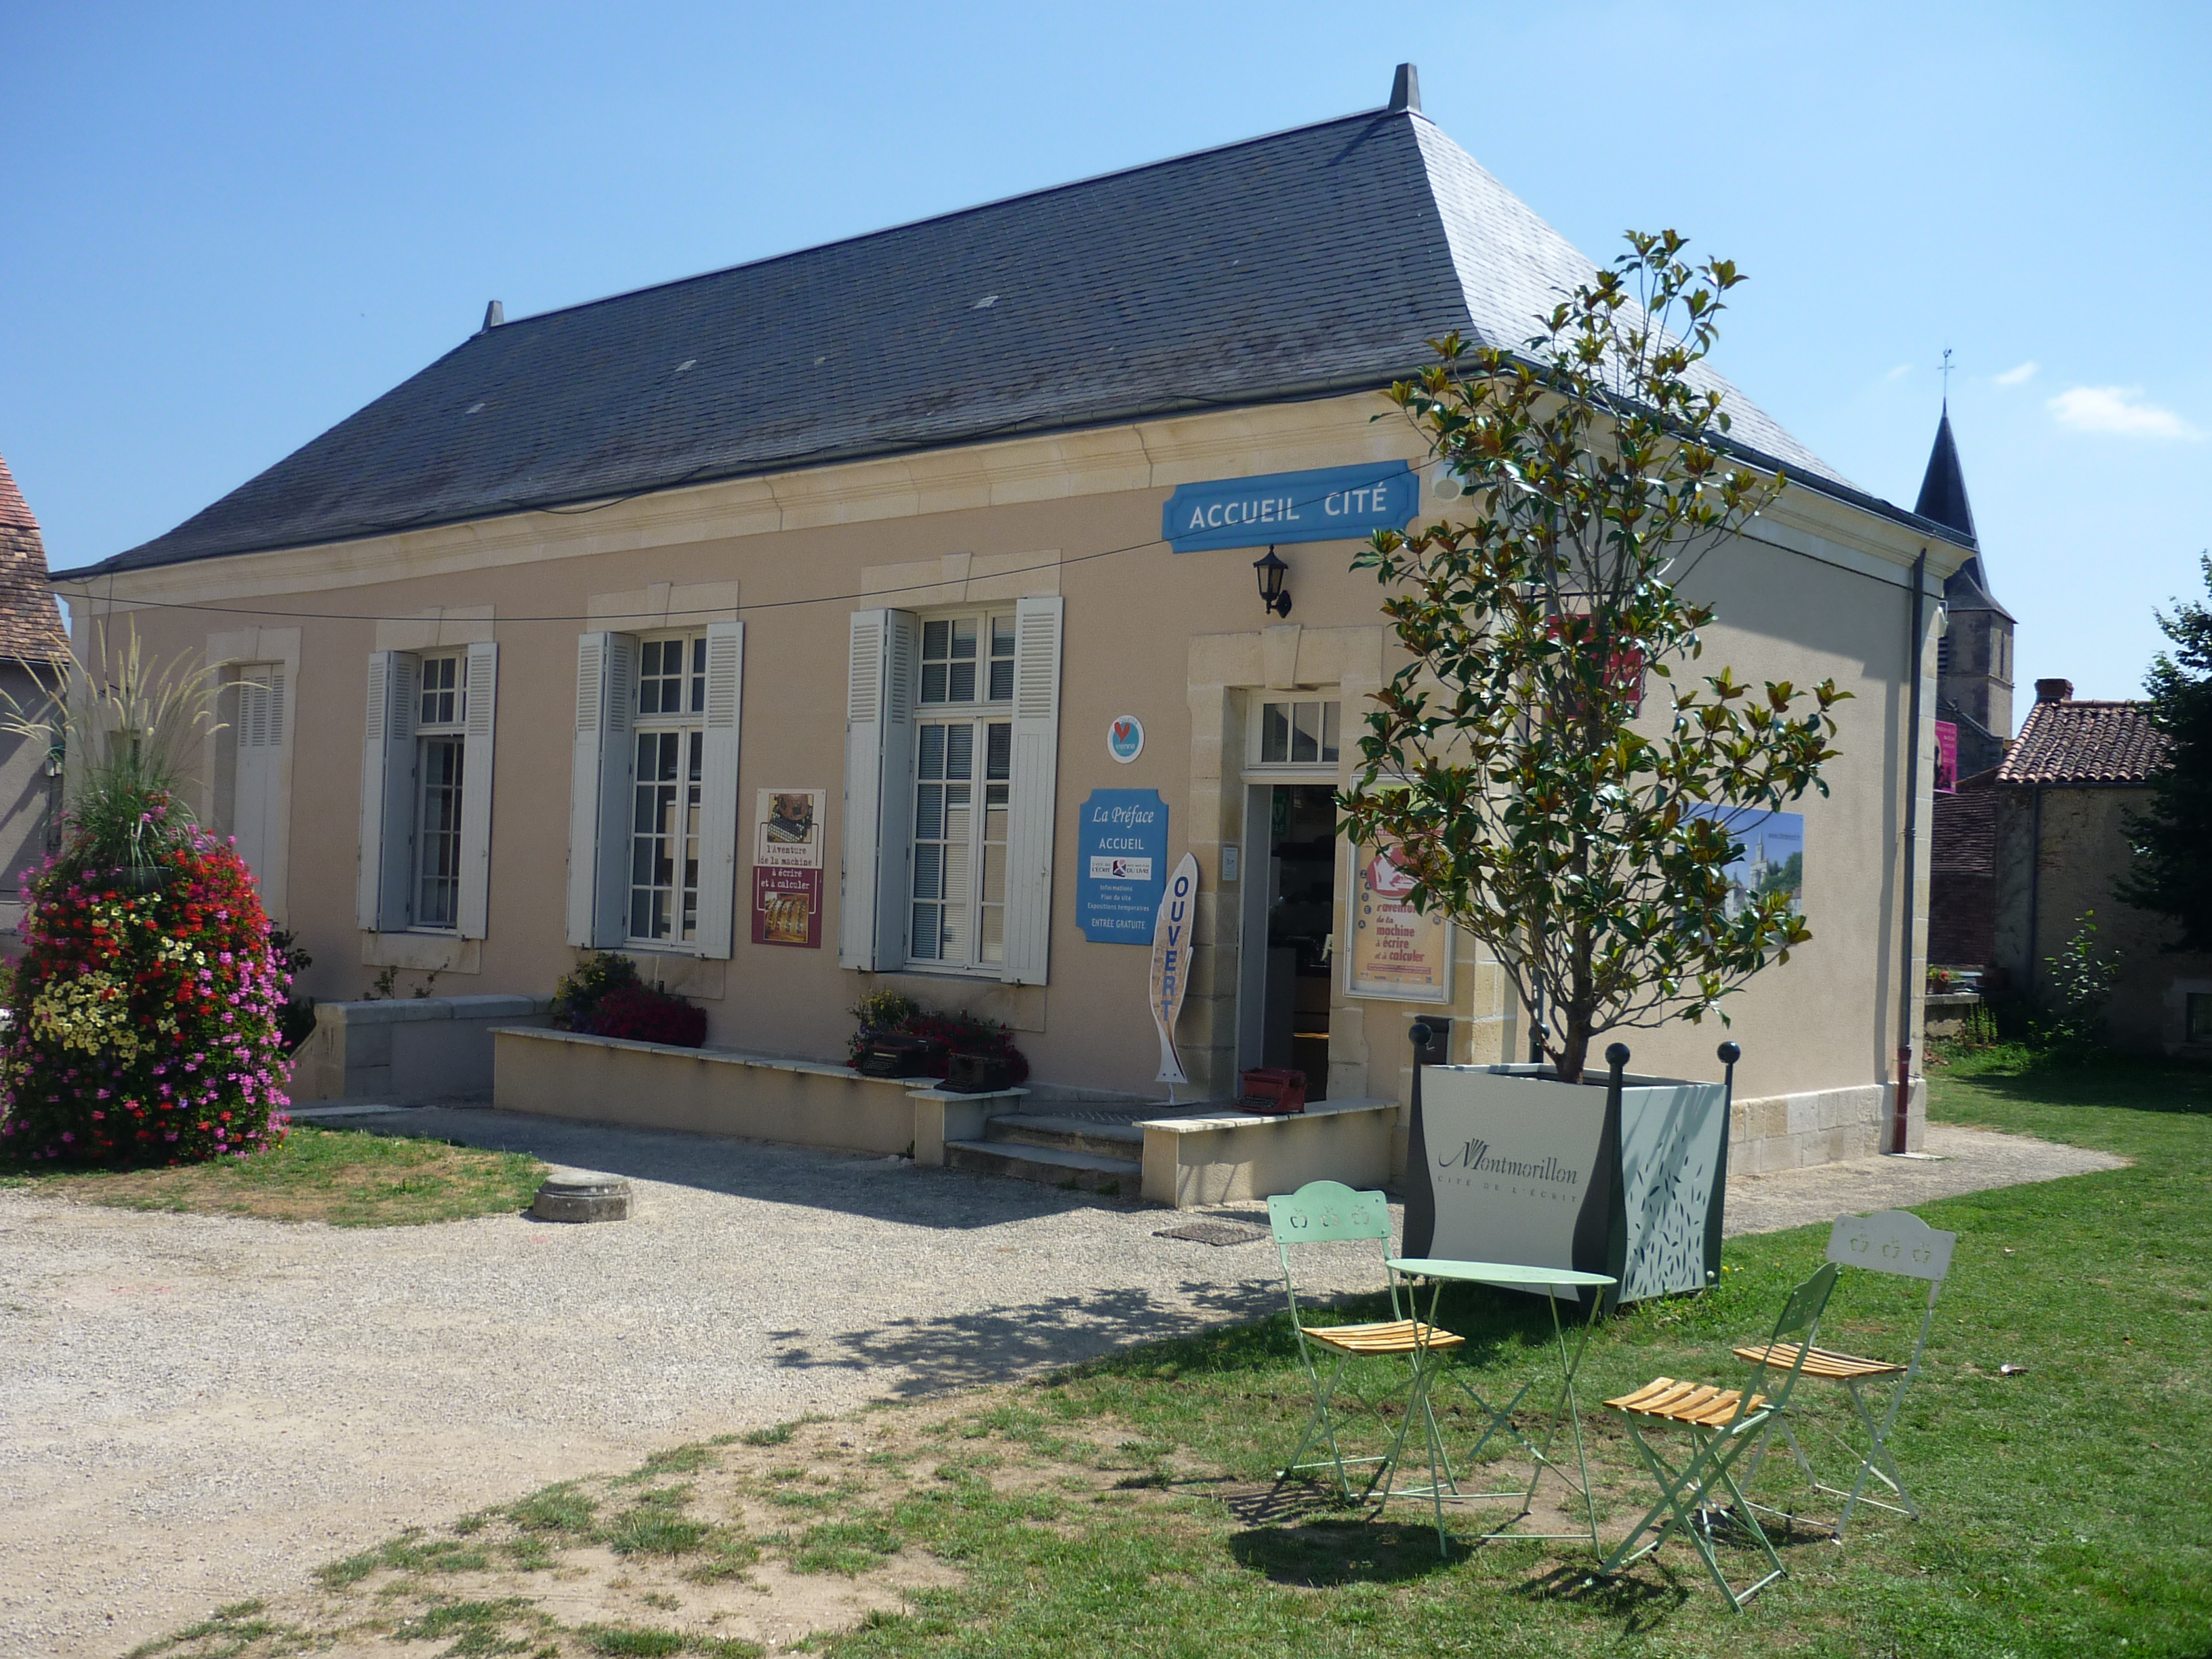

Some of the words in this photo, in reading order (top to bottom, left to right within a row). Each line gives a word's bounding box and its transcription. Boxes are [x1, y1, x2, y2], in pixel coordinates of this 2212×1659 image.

[1189, 497, 1300, 529] ACCUEIL
[1324, 481, 1388, 516] CITÉ
[1092, 806, 1108, 823] La
[1111, 804, 1154, 828] Préface
[766, 844, 807, 855] l'Aventure
[1099, 838, 1144, 850] ACCUEIL
[760, 855, 769, 865] de
[771, 856, 779, 865] la
[781, 857, 813, 867] machine
[772, 868, 777, 877] à
[778, 869, 803, 878] écrire
[760, 880, 769, 888] et
[771, 880, 776, 888] à
[777, 880, 810, 890] calculer
[1087, 902, 1117, 910] Expositions
[1118, 904, 1150, 912] temporaires
[1091, 918, 1115, 928] ENTRÉE
[1115, 919, 1146, 930] GRATUITE
[1376, 915, 1384, 923] de
[1376, 924, 1415, 937] machine
[1160, 876, 1189, 1022] OUVERT
[1375, 939, 1380, 947] à
[1382, 937, 1410, 949] écrire
[1389, 949, 1425, 962] calculer
[1438, 1137, 1579, 1185] Montmorillon
[1437, 1175, 1471, 1186] CITÉ
[1483, 1182, 1500, 1191] DE
[1513, 1187, 1579, 1203] L'ÉCRIT
